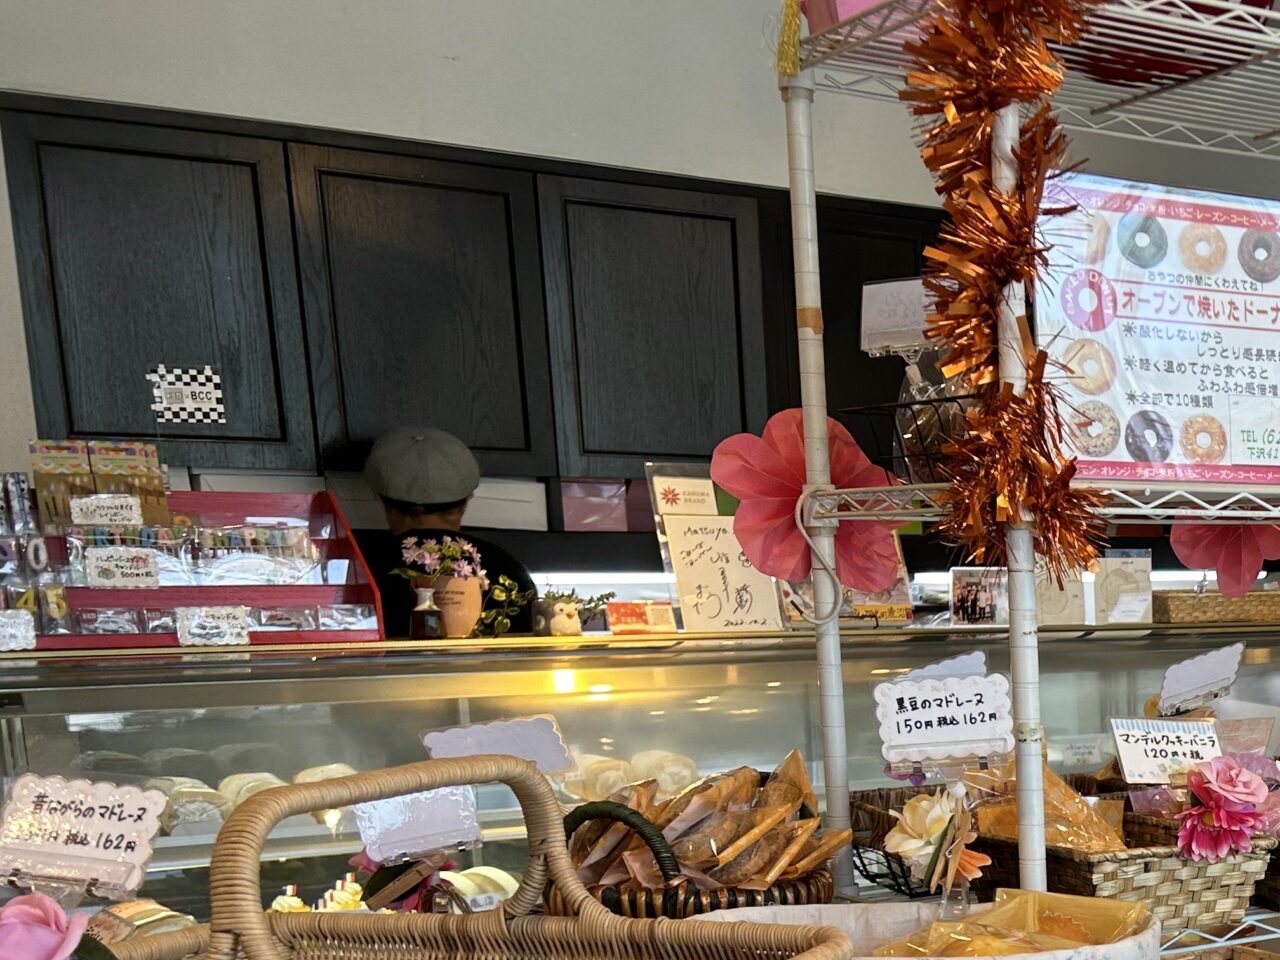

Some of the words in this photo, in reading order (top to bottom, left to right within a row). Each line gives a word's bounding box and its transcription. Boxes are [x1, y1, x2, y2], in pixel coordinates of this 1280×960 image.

[190, 391, 213, 401] BCC
[1240, 429, 1258, 443] TEL
[896, 693, 985, 715] 黒豆のマドレーヌ
[896, 719, 934, 735] 150円
[937, 715, 960, 728] 税込
[963, 711, 997, 726] 162円
[1119, 730, 1216, 748] マンデルクッキーバニラ
[32, 792, 147, 823] 昔ながらのマドレーヌ
[96, 832, 137, 852] 162円
